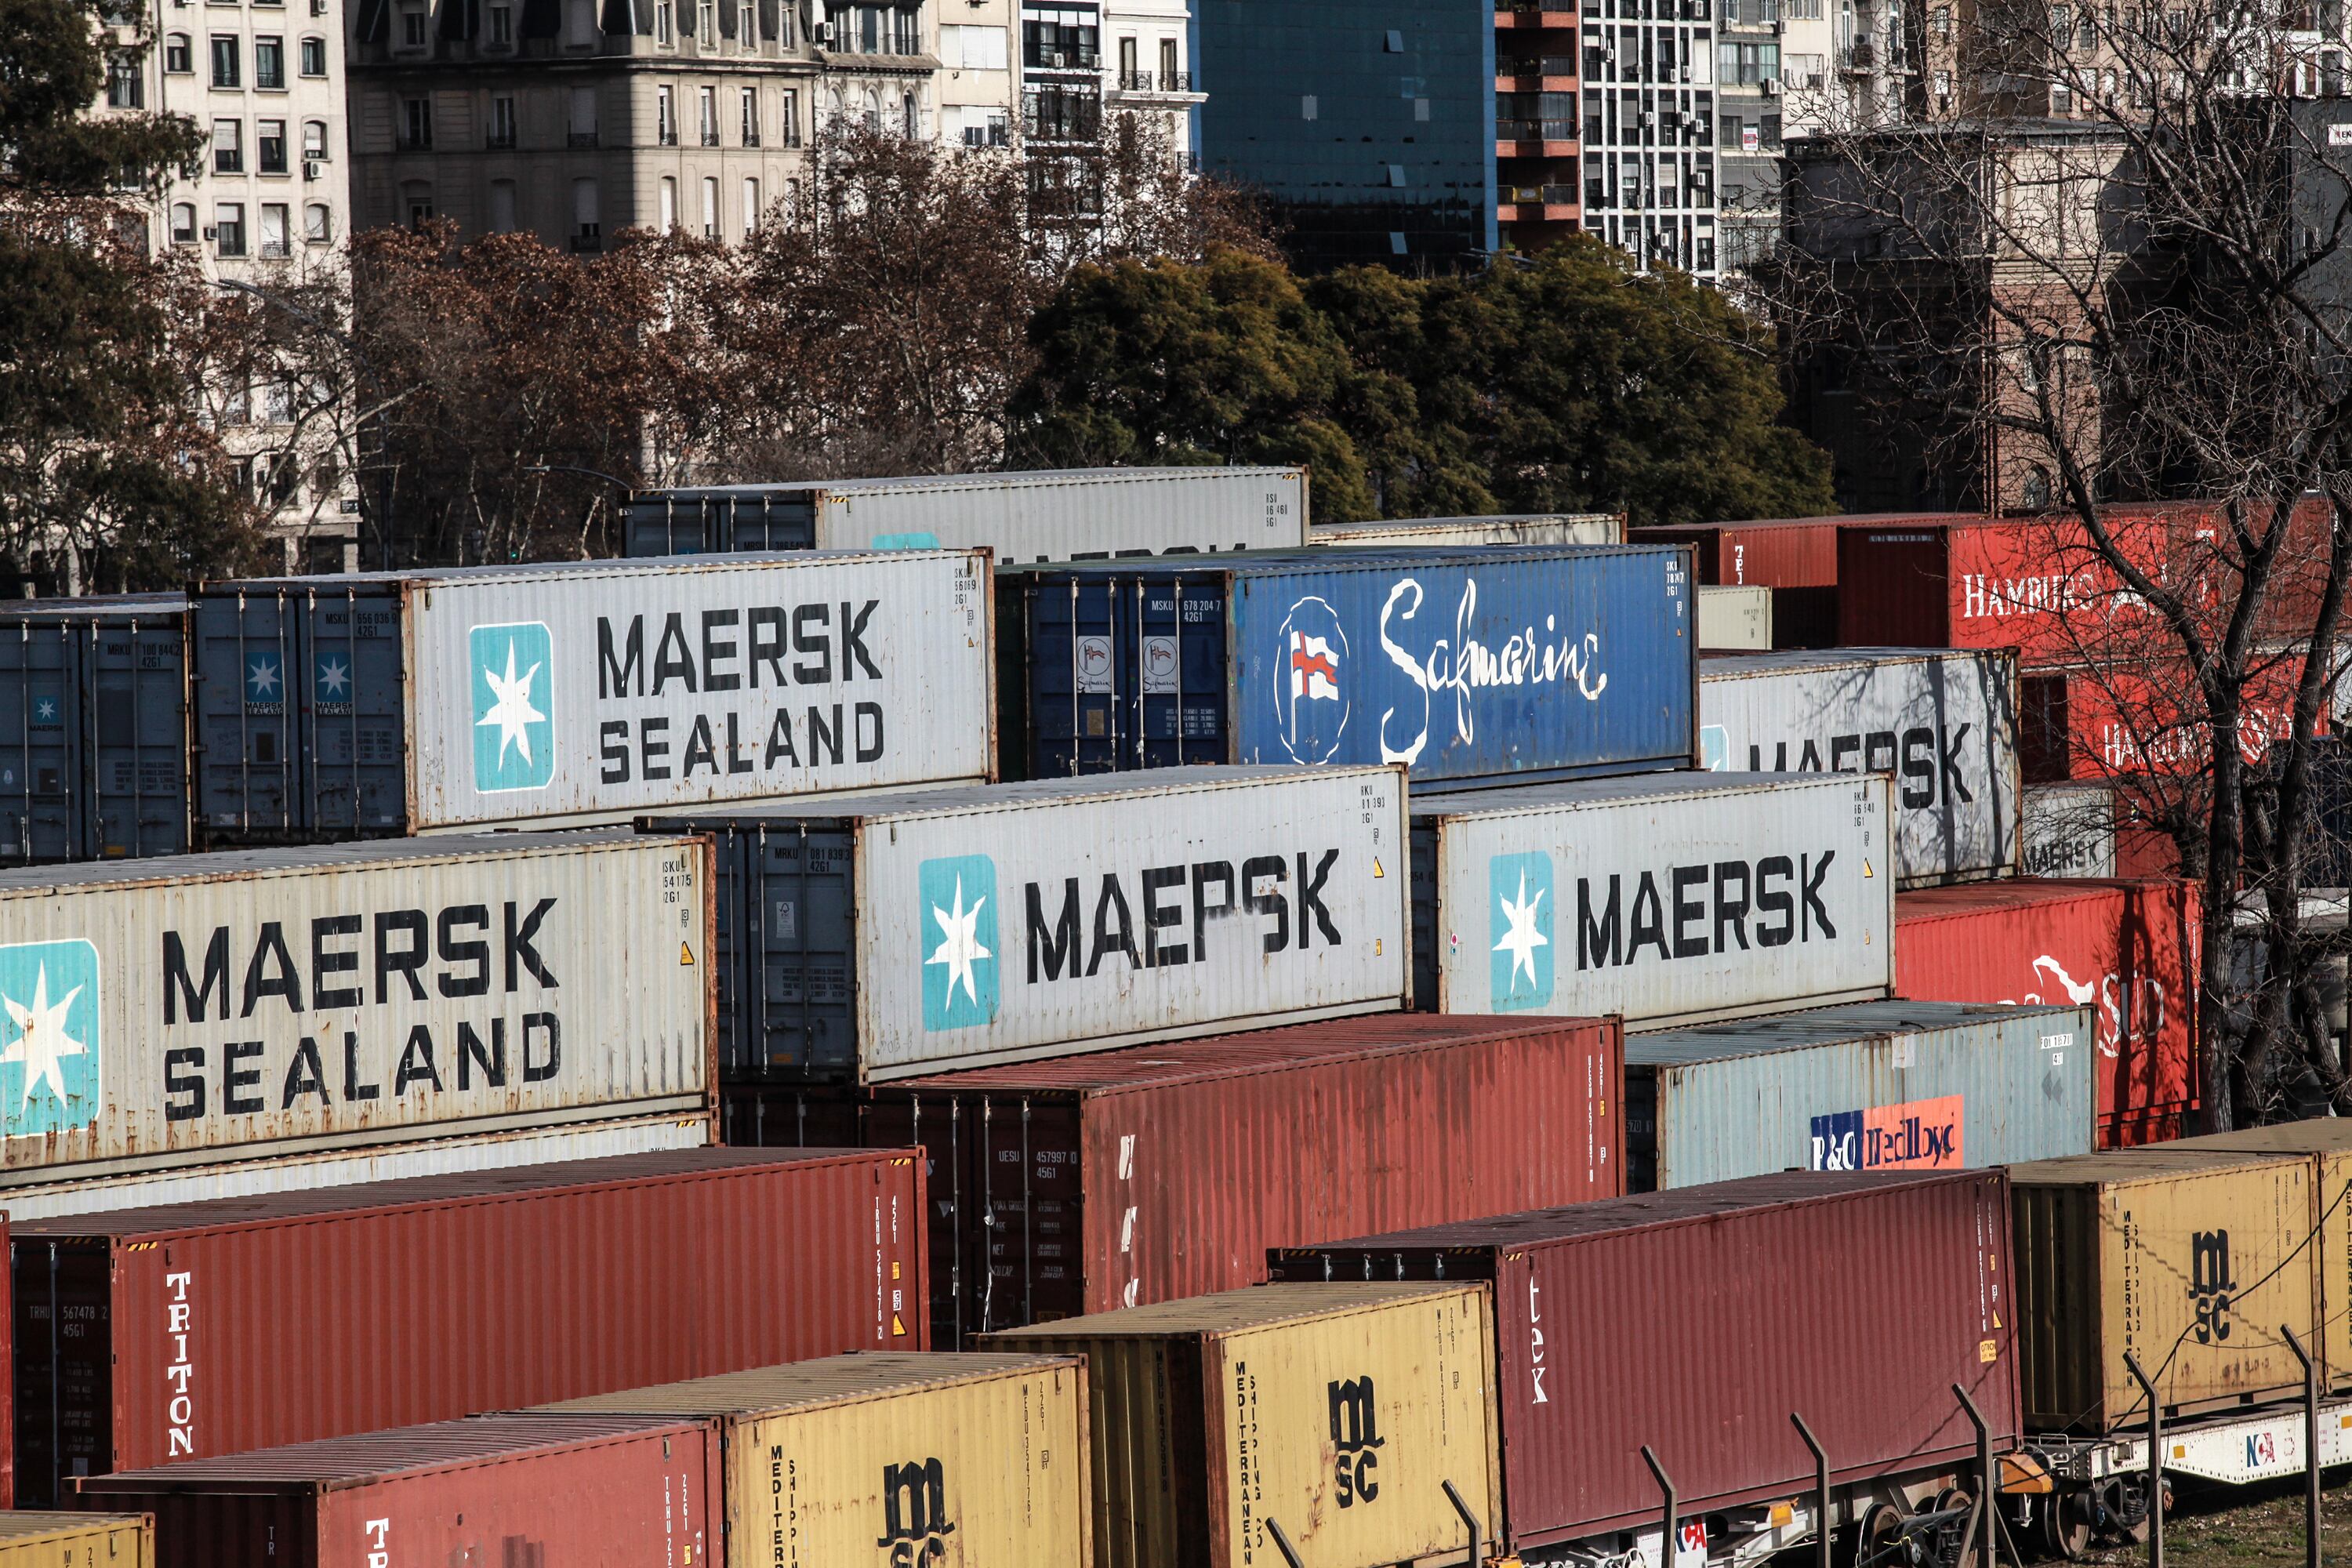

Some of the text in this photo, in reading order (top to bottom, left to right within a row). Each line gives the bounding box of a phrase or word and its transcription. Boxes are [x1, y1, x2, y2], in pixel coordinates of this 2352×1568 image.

[1151, 600, 1174, 611] MSKU
[1184, 600, 1198, 611] 678
[1200, 600, 1214, 611] 204
[1184, 612, 1203, 622] 42G1
[325, 613, 349, 625] MSKU
[357, 613, 372, 625] 656
[374, 613, 390, 625] 036
[357, 626, 378, 637] 42G1
[107, 644, 131, 656] MRKU
[143, 644, 156, 656] 100
[596, 600, 884, 699] MAERSK
[1077, 676, 1112, 693] Safmarin
[600, 702, 885, 784] SEALAND
[662, 860, 680, 873] SKU
[775, 847, 798, 860] MRKU
[810, 848, 825, 860] 081
[828, 848, 844, 861] 839
[2022, 840, 2098, 874] MAERSK
[810, 861, 829, 873] 42G1
[1577, 850, 1838, 971] MAERSK
[162, 897, 560, 1026] MAERSK
[164, 1011, 561, 1122] SEALAND
[998, 1150, 1020, 1162] UESU
[1036, 1151, 1067, 1163] 457997
[1812, 1131, 1857, 1171] P&O
[1036, 1167, 1056, 1179] 45G1
[2123, 1210, 2133, 1387] MEDITERRANAN
[29, 1305, 51, 1319] TRHU
[63, 1305, 95, 1319] 567478
[63, 1323, 85, 1337] 45G1
[1529, 1276, 1549, 1405] tex
[166, 1271, 194, 1457] TRITON
[1250, 1375, 1261, 1501] SHIPPING
[1236, 1361, 1252, 1566] MEDITERRANEAN
[771, 1445, 783, 1568] MEDITER
